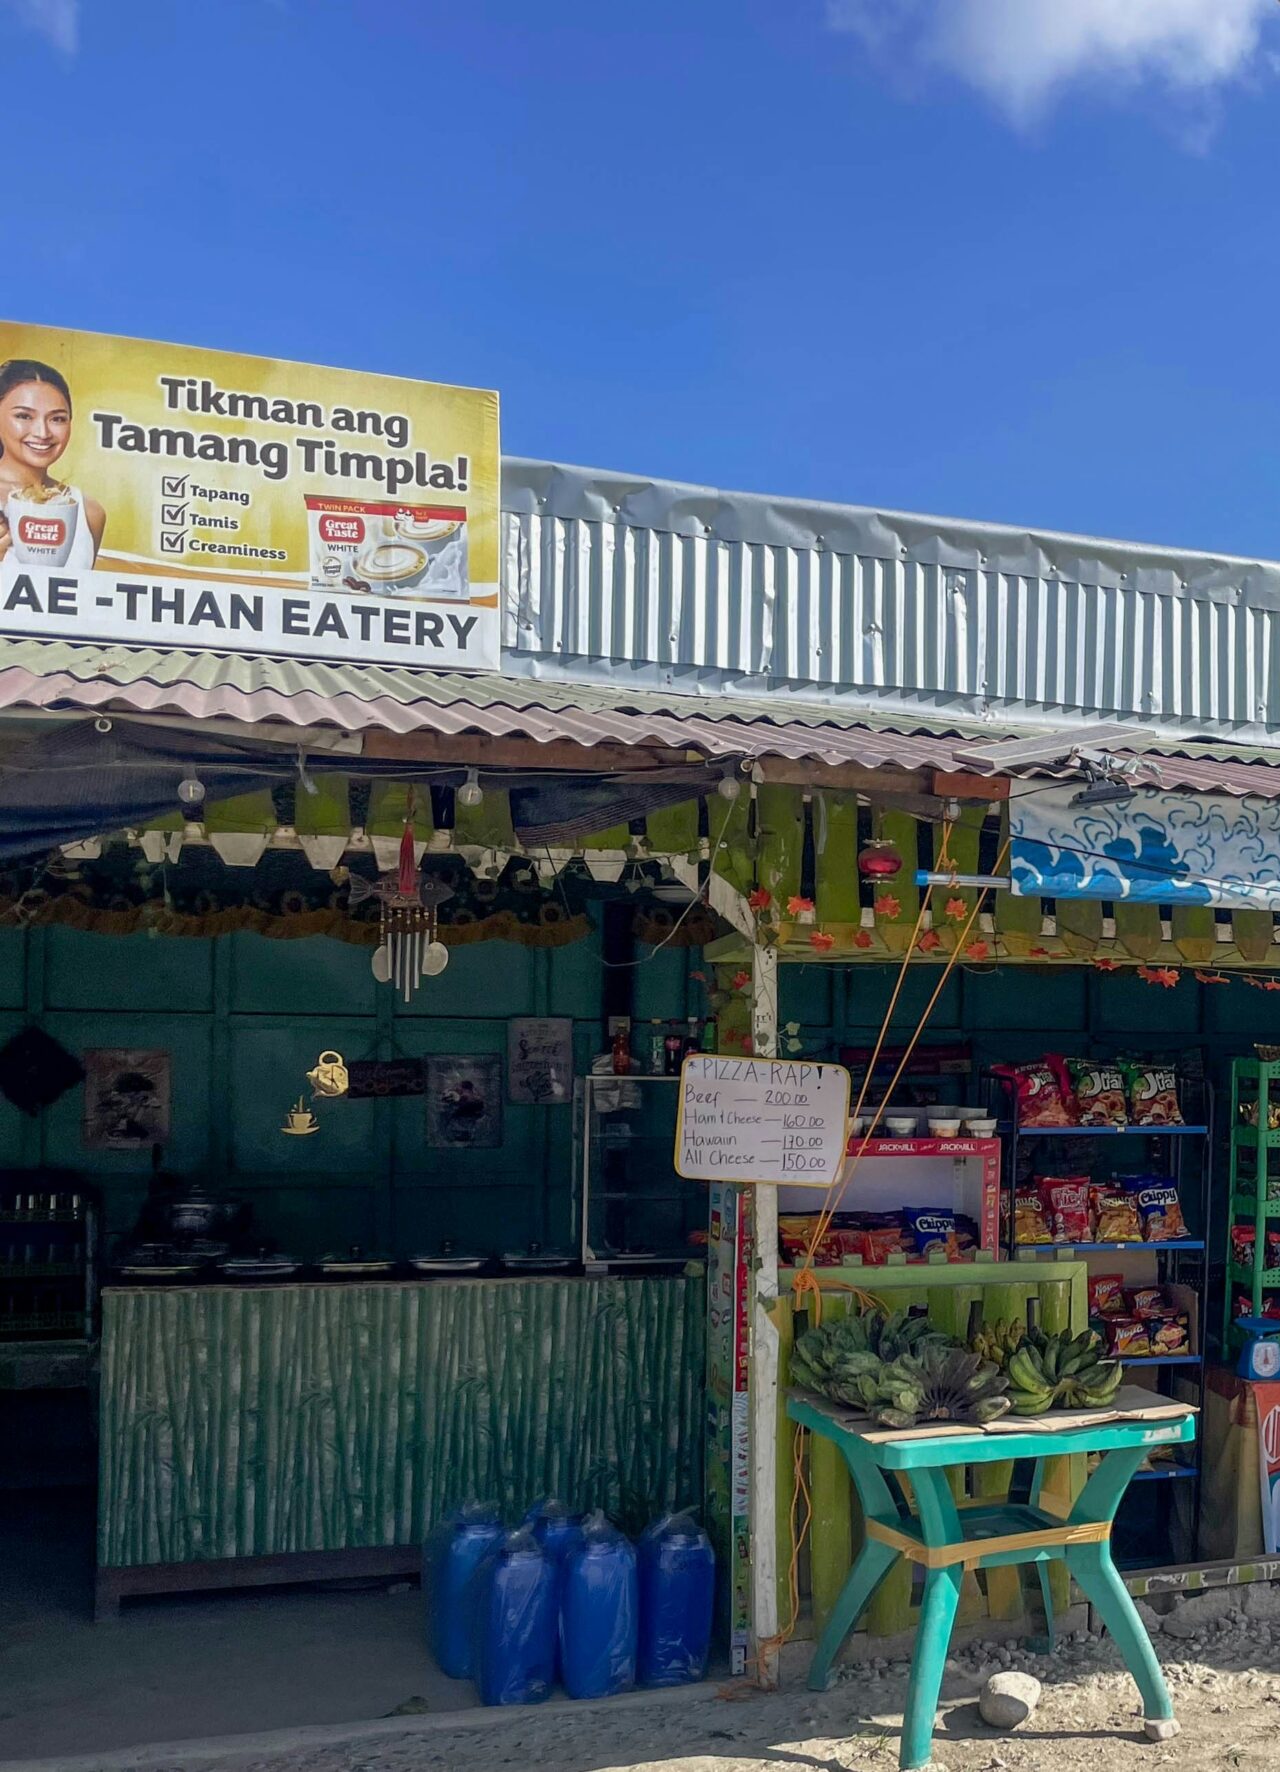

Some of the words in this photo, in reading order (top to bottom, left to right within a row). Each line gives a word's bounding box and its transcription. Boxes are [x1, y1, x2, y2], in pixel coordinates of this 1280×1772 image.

[160, 377, 324, 428] Tikman
[331, 407, 408, 448] ang
[93, 413, 288, 480] Tamang
[296, 438, 468, 494] Timpla!
[190, 485, 250, 506] Tapang
[318, 503, 342, 512] TWIN
[343, 504, 366, 513] PACK
[25, 521, 59, 533] Great
[189, 513, 239, 529] Tamis
[325, 519, 358, 530] Great
[25, 529, 59, 541] Taste
[326, 528, 359, 539] Taste
[27, 546, 57, 555] WHITE
[188, 539, 286, 560] Creaminess
[327, 543, 359, 553] WHITE
[3, 574, 78, 616] AE
[283, 600, 478, 650] EATERY
[703, 1058, 823, 1090] PIZZA-RAP!
[685, 1084, 722, 1108] Beef
[685, 1108, 717, 1126] Ham
[727, 1111, 762, 1125] Cheese
[685, 1149, 702, 1166] All
[709, 1150, 756, 1166] Cheese
[1140, 1188, 1177, 1204] Chippy
